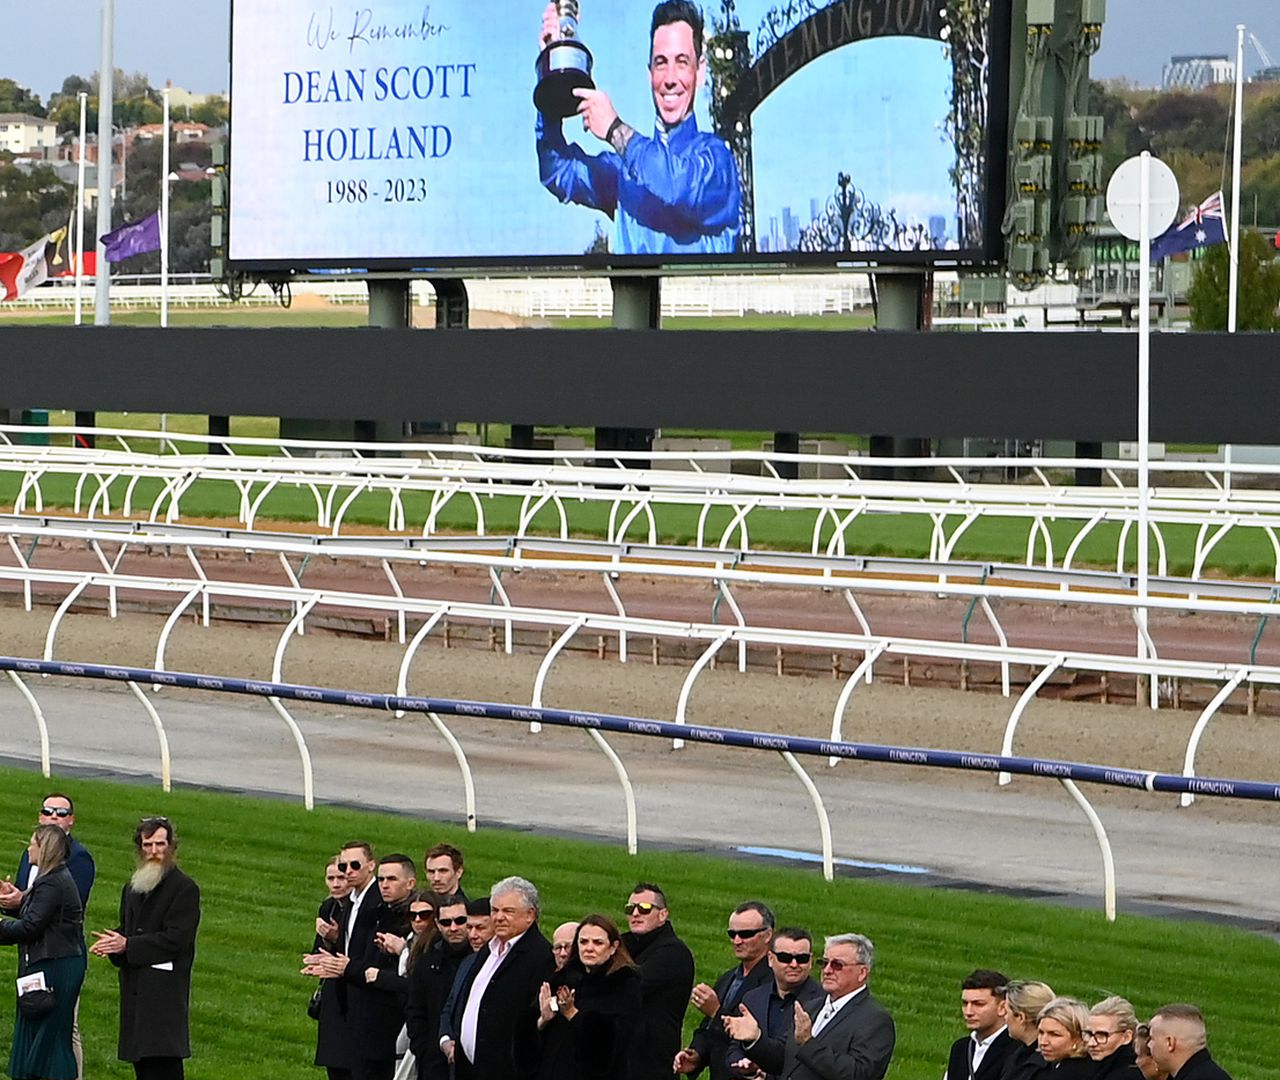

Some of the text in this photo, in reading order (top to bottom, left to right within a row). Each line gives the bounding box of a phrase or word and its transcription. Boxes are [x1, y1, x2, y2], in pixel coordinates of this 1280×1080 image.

[306, 5, 451, 54] We Remember
[283, 63, 477, 104] DEAN SCOTT
[303, 125, 452, 161] HOLLAND
[327, 179, 368, 203] 1988
[384, 178, 427, 202] 2023
[1188, 779, 1235, 795] FLEMINGTON
